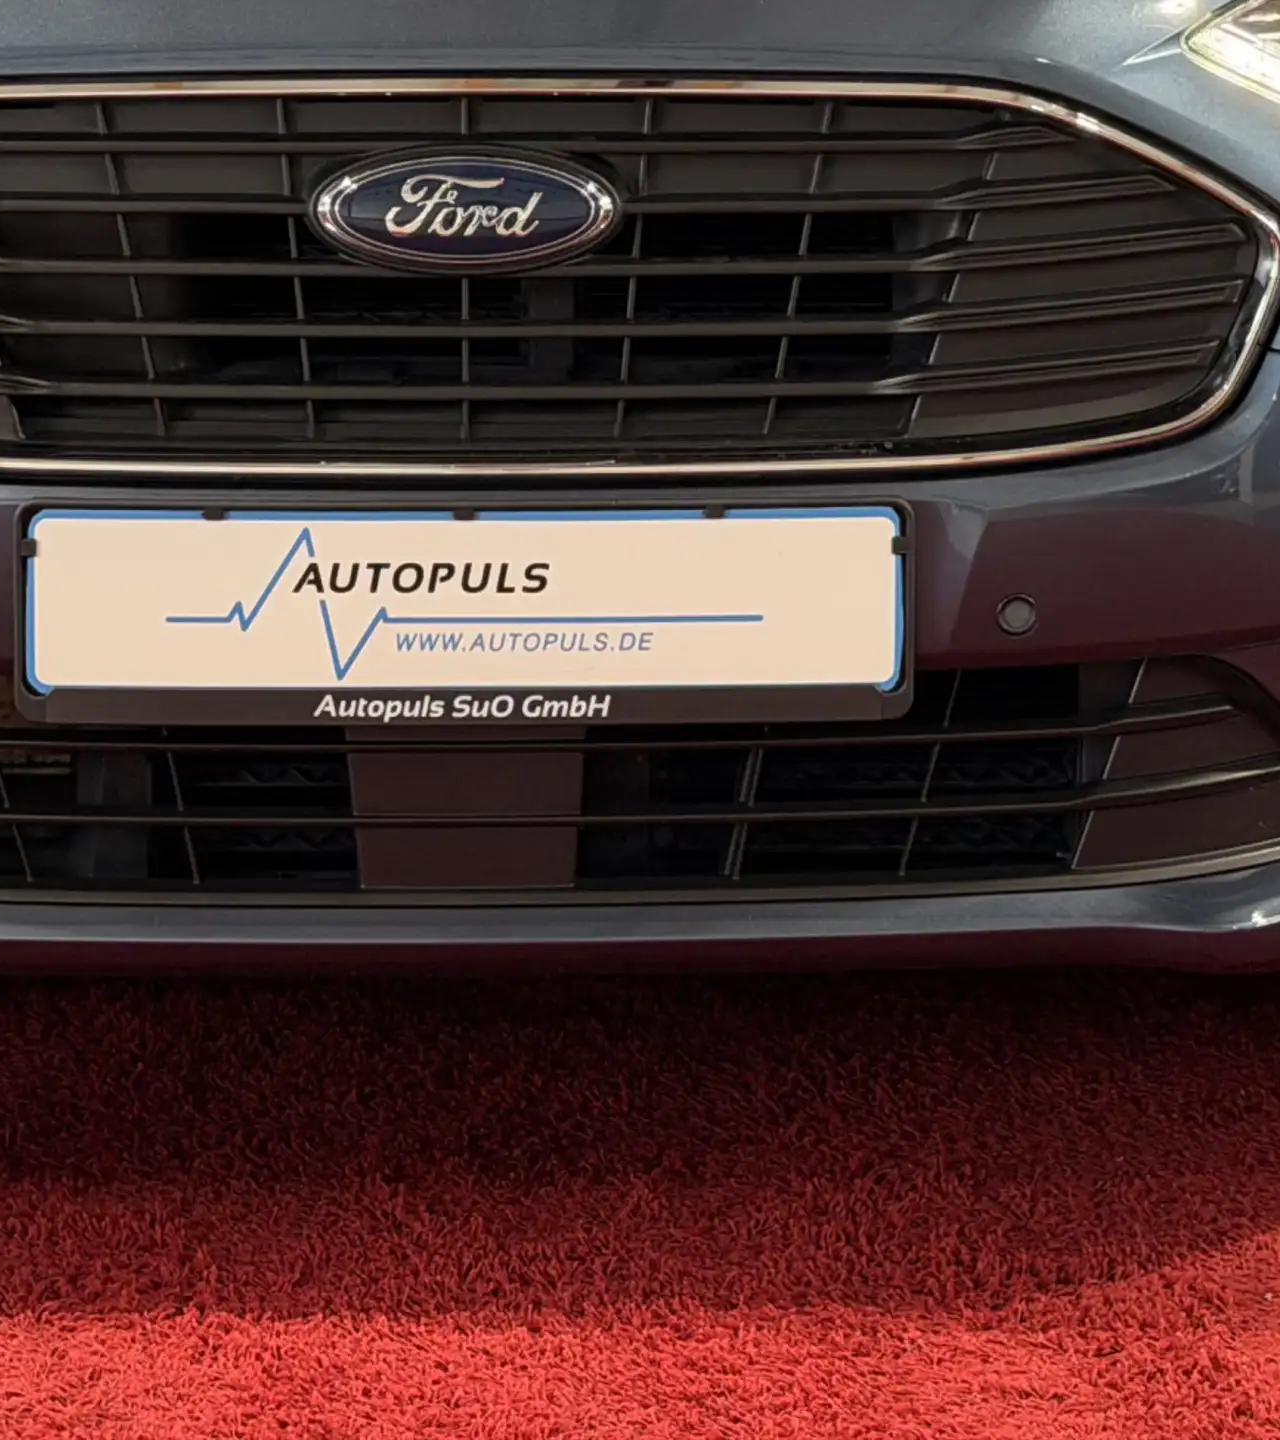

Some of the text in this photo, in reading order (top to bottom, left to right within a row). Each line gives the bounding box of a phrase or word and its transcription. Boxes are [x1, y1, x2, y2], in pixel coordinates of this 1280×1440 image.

[385, 174, 542, 237] Ford
[293, 562, 551, 594] AUTOPULS
[395, 632, 654, 653] WWW.AUTOPULS.DE
[313, 693, 612, 723] Autopuls SuO GmbH
